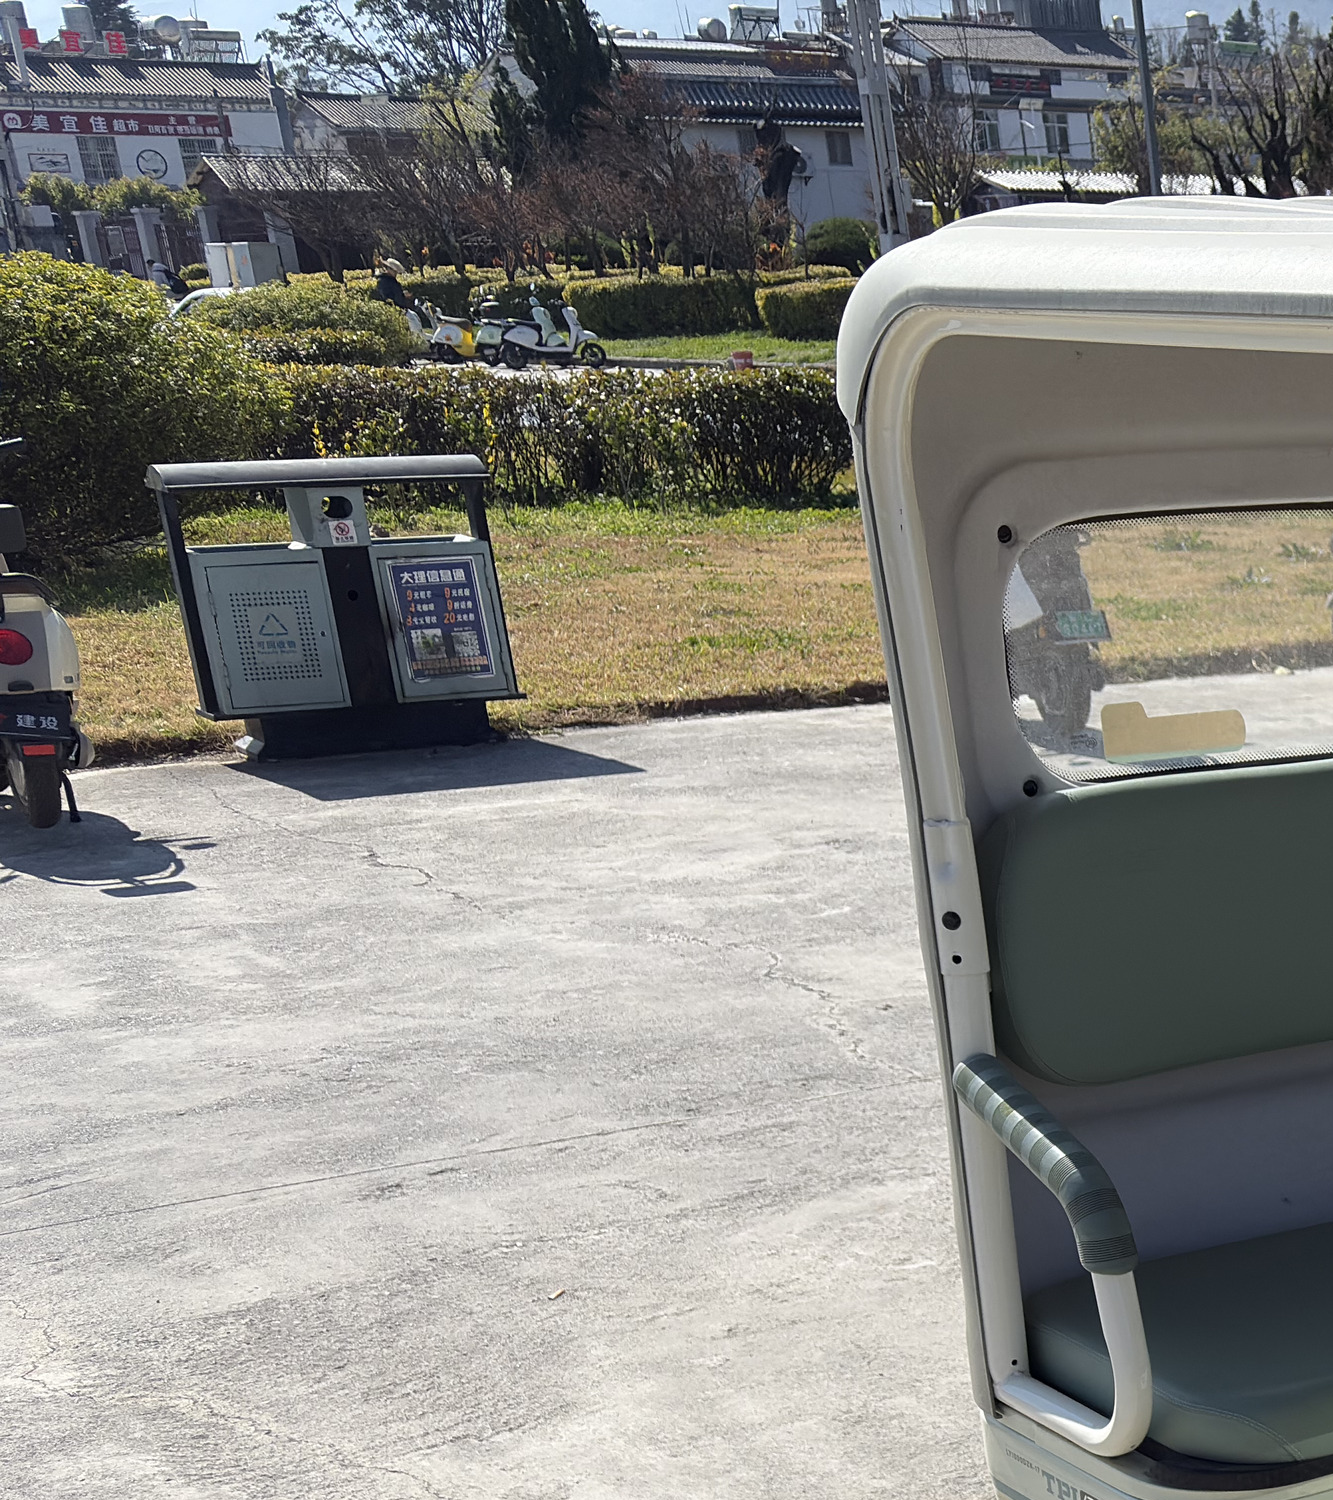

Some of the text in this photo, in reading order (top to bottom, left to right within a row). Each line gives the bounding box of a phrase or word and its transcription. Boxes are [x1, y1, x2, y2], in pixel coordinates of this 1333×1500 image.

[400, 568, 466, 584] 大理信息通
[16, 714, 59, 730] 建设
